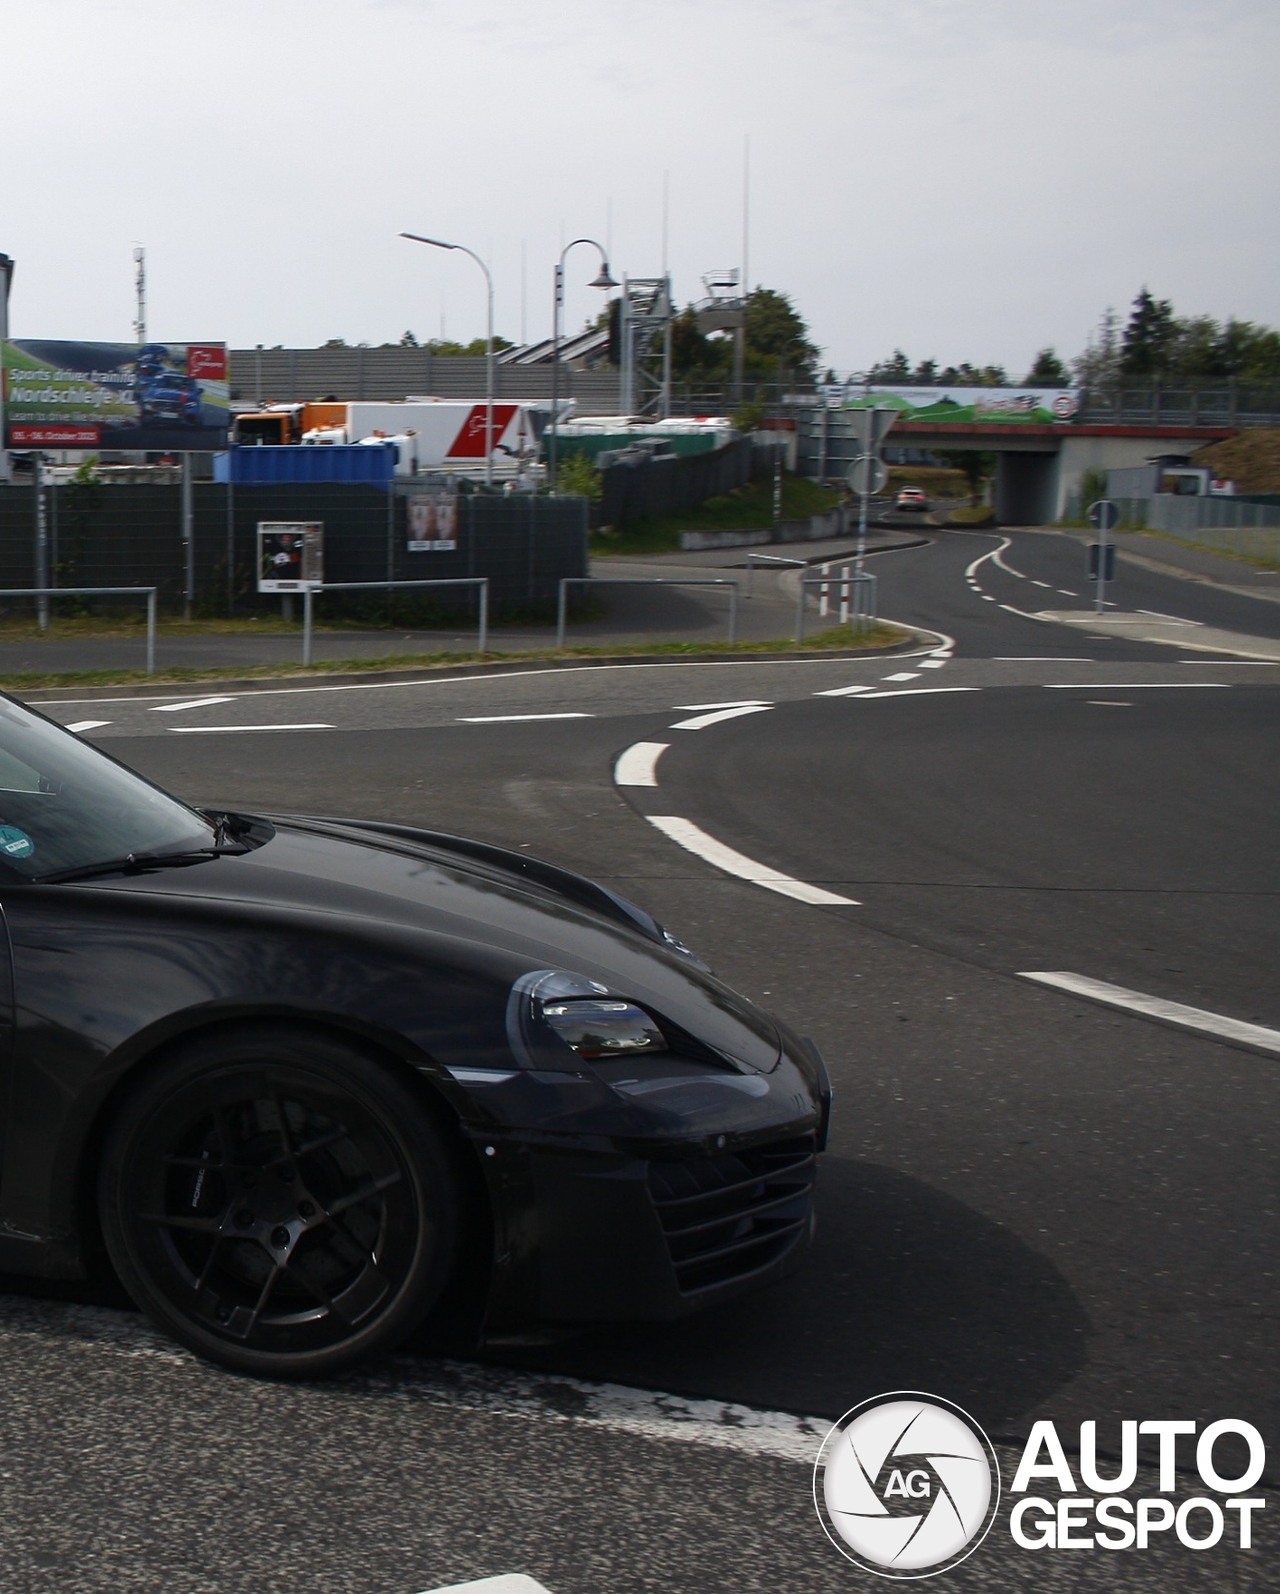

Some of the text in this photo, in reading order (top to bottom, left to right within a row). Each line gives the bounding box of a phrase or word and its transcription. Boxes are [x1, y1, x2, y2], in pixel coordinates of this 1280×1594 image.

[8, 368, 138, 386] Sports driver training
[9, 386, 112, 408] Nordschleife
[192, 1151, 209, 1207] PORSCE
